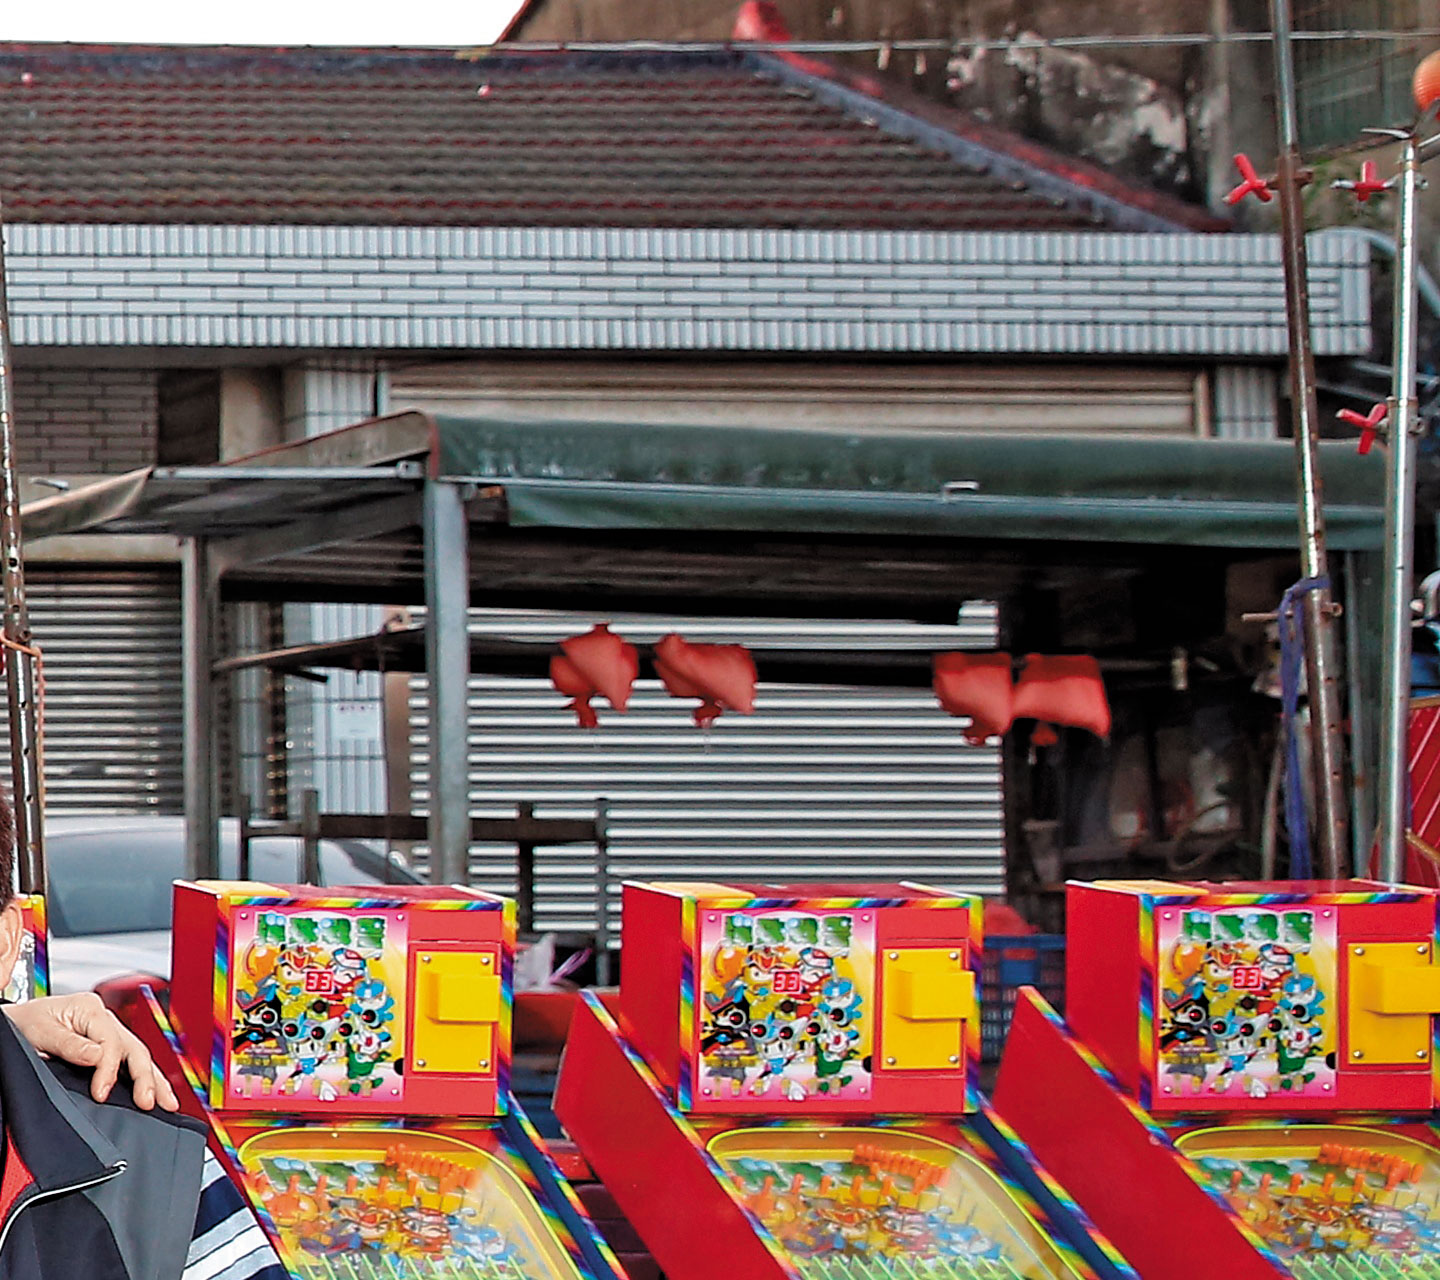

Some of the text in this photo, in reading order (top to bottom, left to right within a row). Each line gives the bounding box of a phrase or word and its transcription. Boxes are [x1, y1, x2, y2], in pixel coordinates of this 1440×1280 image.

[307, 973, 333, 991] 33
[774, 973, 800, 991] 33
[1233, 970, 1260, 988] 33
